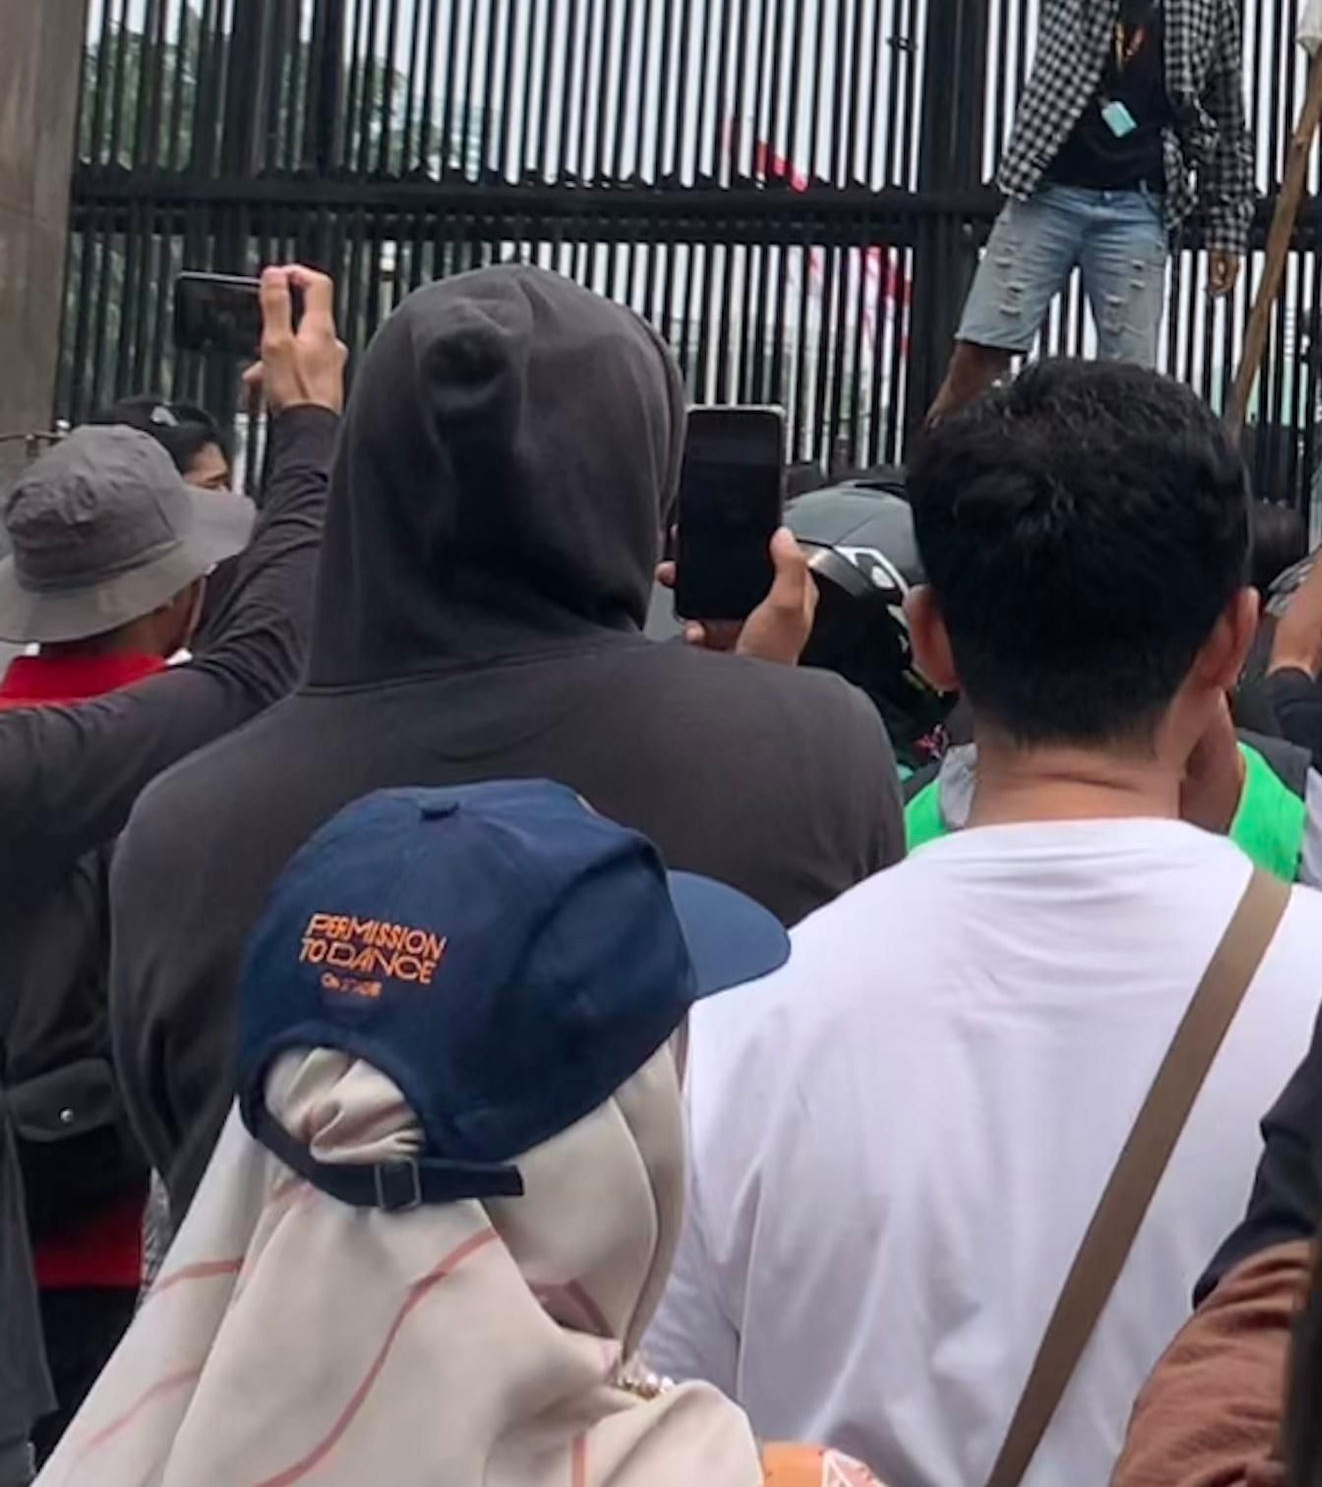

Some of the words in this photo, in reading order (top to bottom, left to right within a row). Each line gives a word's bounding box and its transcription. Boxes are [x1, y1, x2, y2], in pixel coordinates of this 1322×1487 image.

[306, 913, 447, 959] PERMISSION
[299, 937, 327, 963] TO
[326, 940, 438, 985] DANCE
